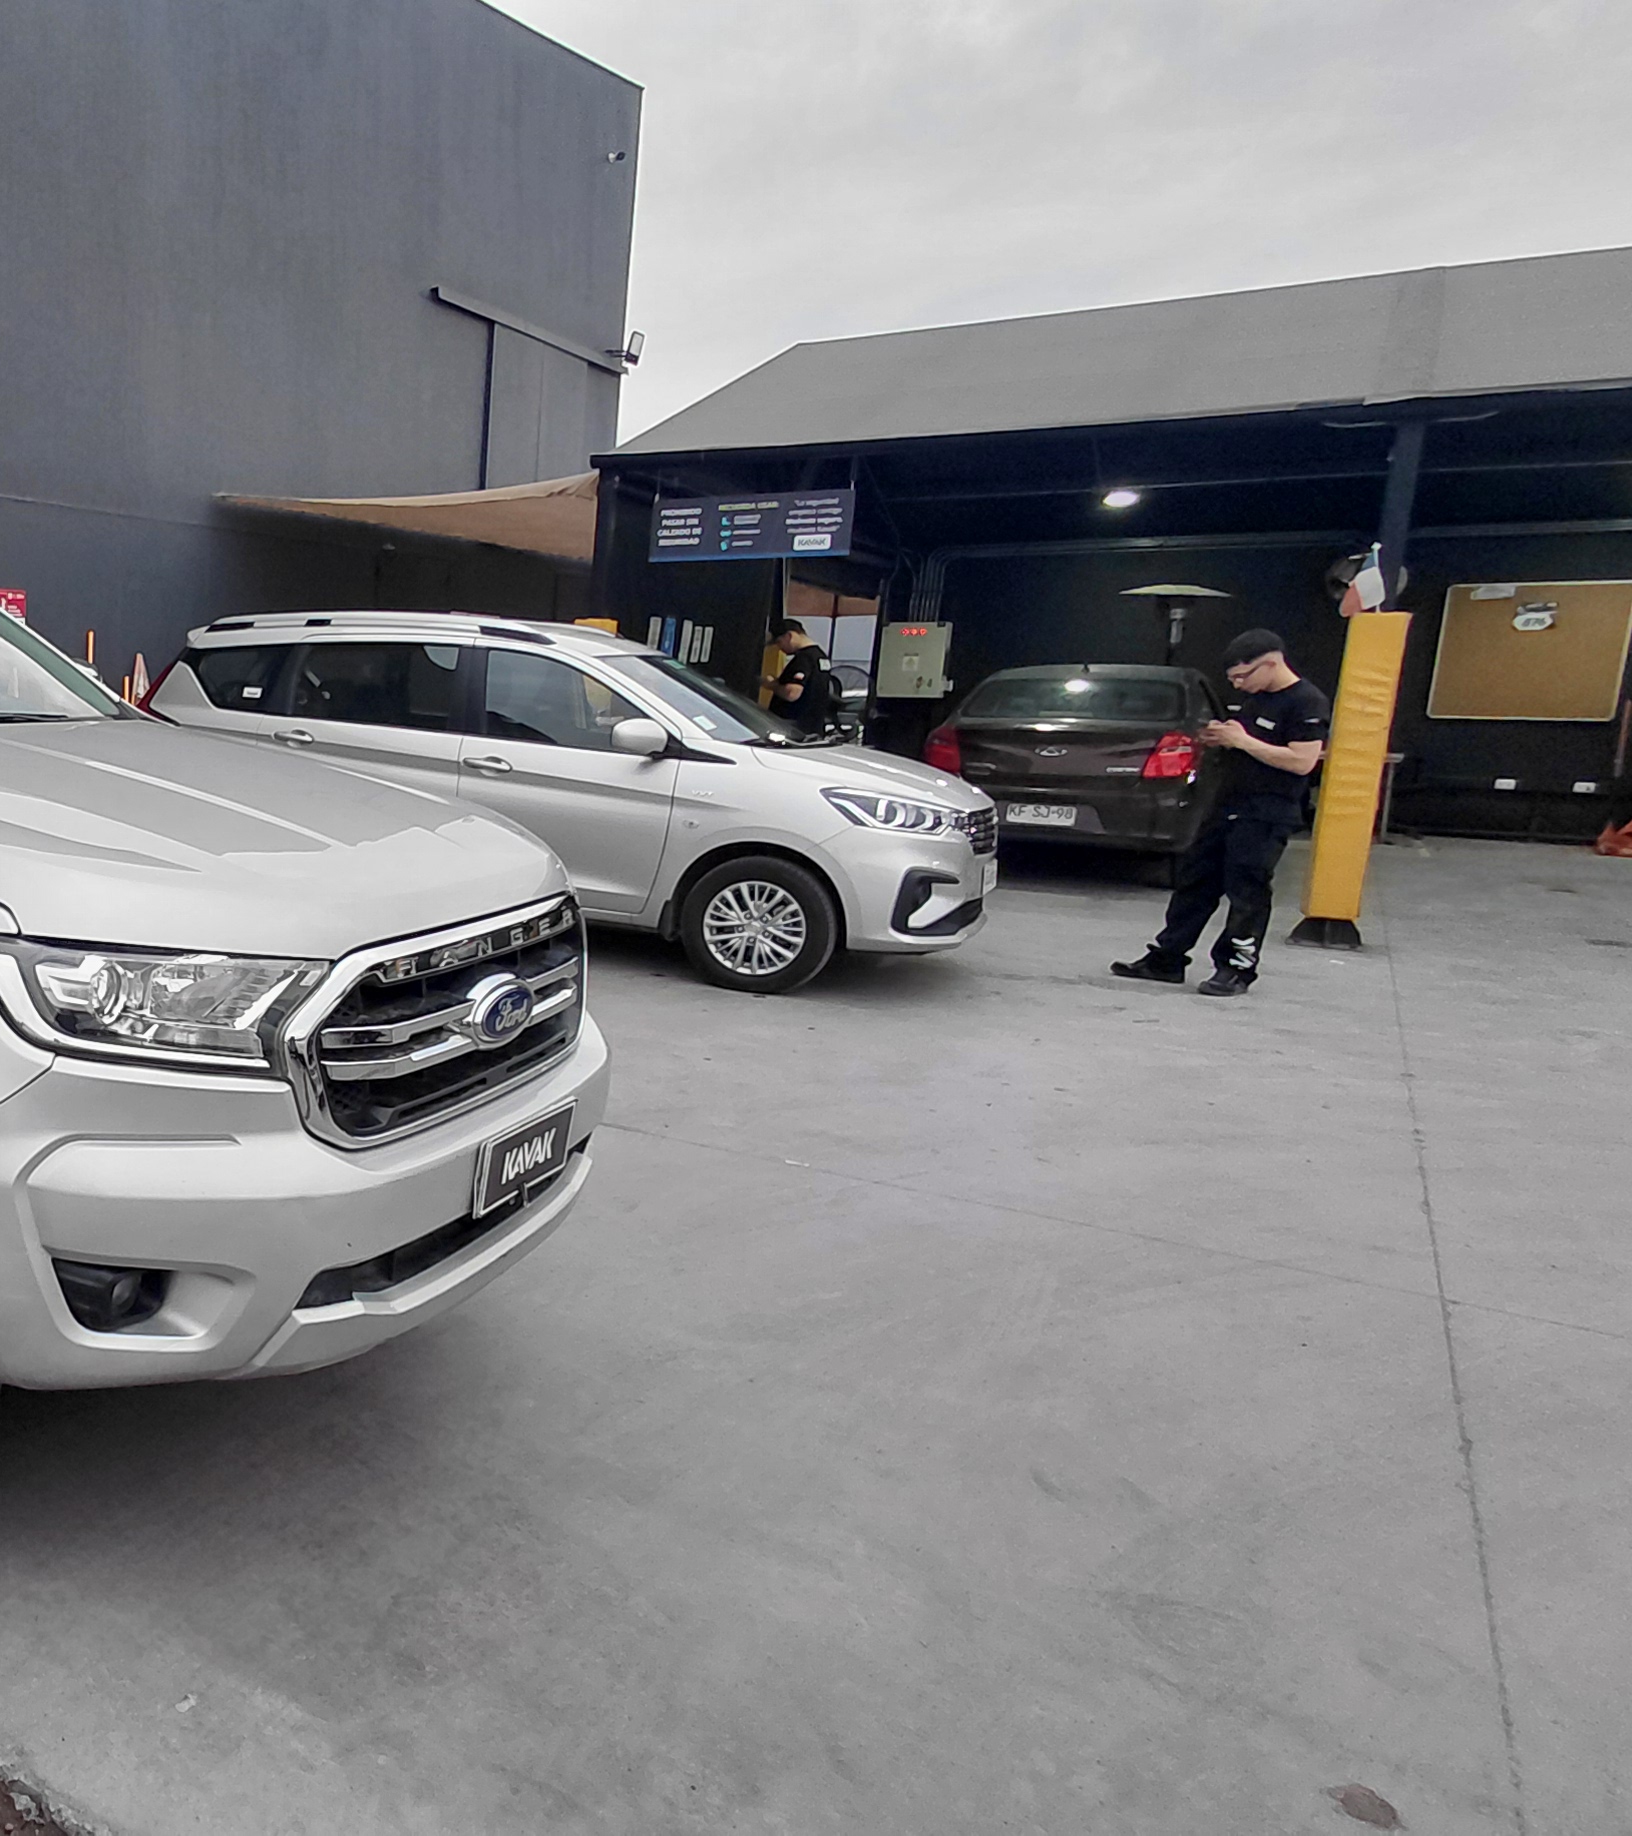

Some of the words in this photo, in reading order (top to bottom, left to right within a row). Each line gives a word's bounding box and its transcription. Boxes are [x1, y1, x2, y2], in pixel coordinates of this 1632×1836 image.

[1009, 805, 1027, 817] KF
[395, 905, 576, 980] RANGER
[494, 993, 528, 1032] Ford
[500, 1126, 557, 1185] KAVAK
